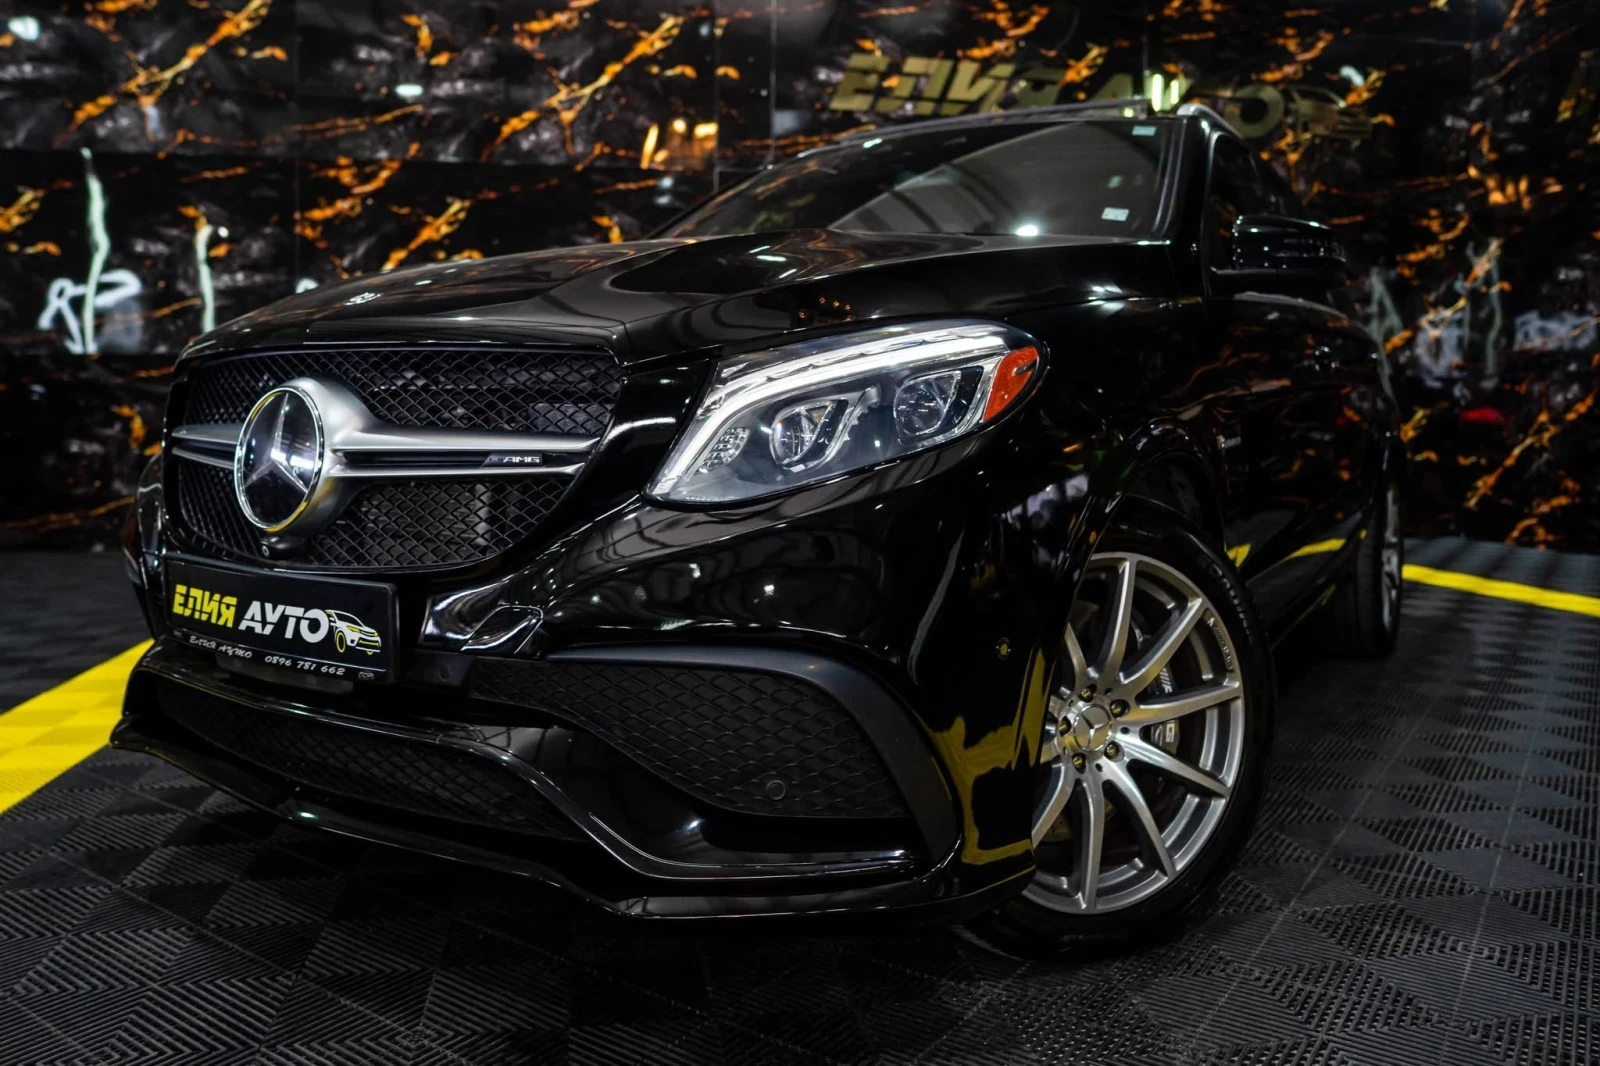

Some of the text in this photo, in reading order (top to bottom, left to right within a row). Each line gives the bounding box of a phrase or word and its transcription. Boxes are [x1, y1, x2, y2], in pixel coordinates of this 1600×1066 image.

[172, 584, 329, 643] ЕЛИЯ АУТО
[264, 656, 292, 667] 0896
[296, 661, 317, 671] 781
[320, 665, 346, 676] 662
